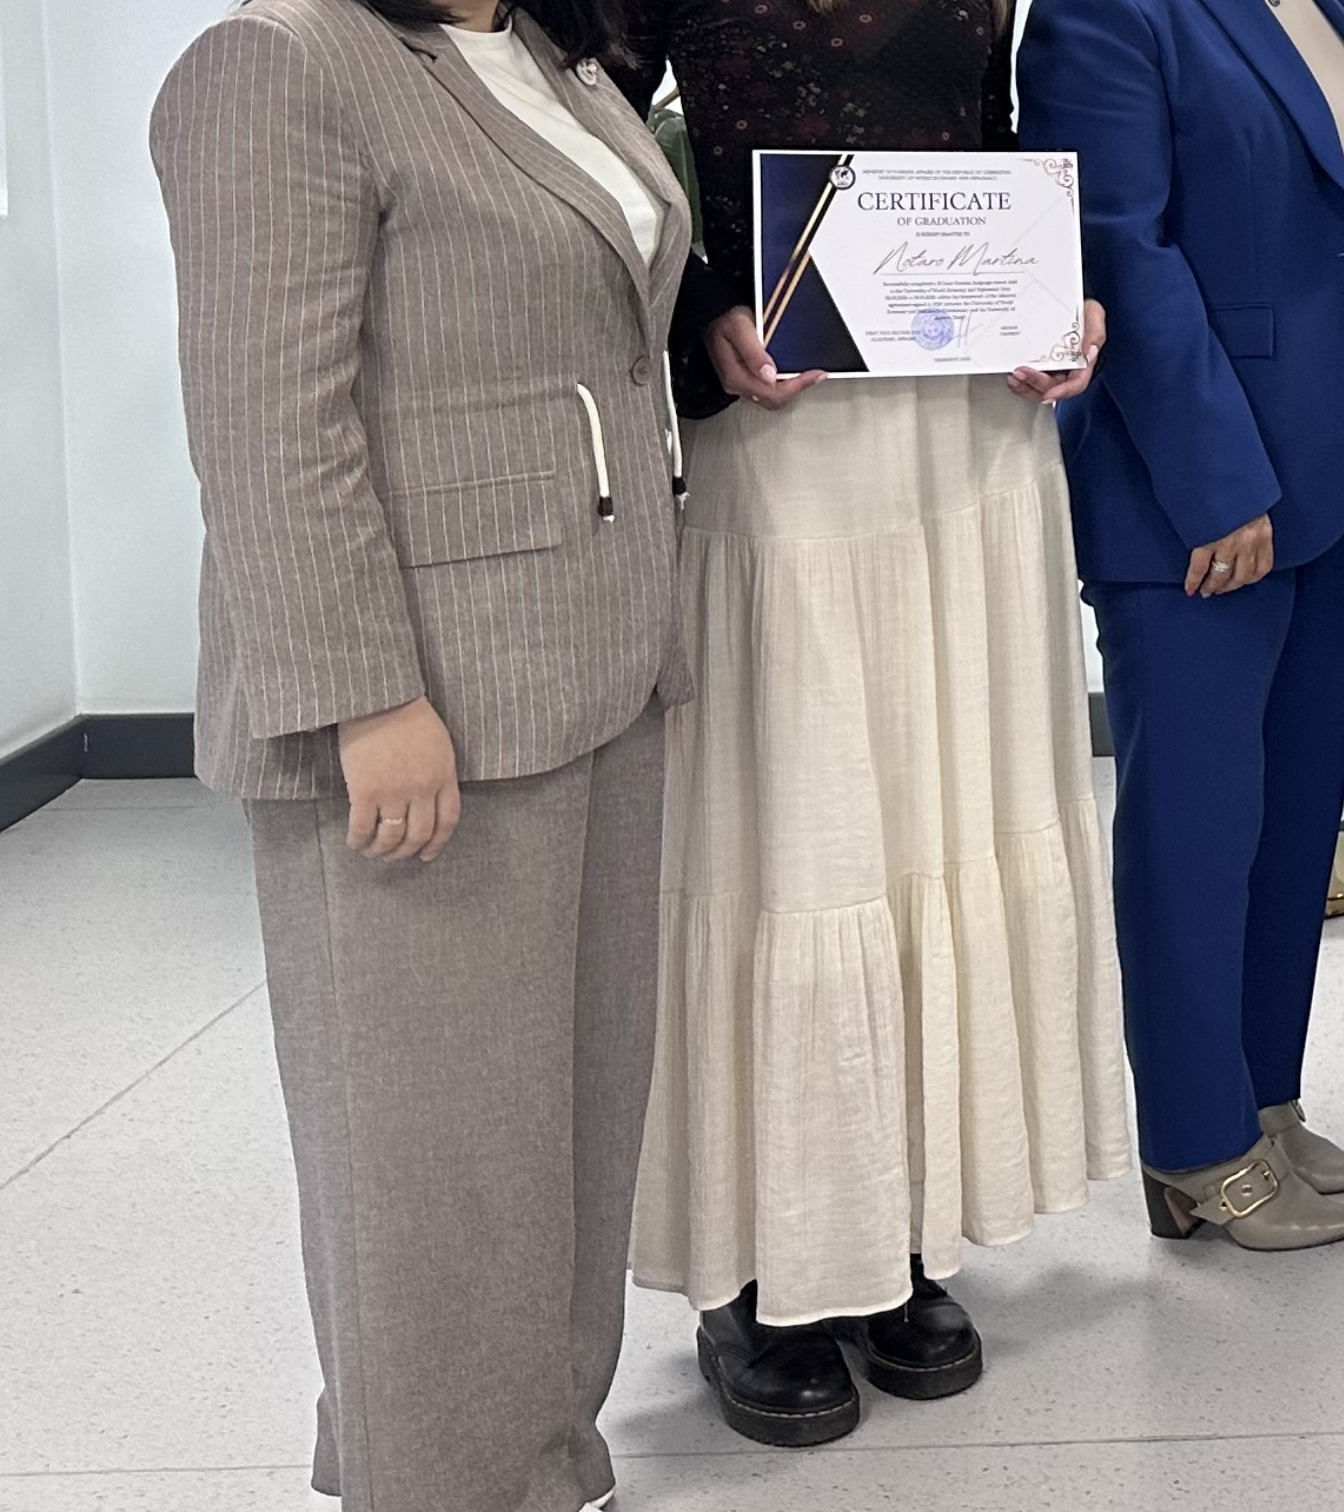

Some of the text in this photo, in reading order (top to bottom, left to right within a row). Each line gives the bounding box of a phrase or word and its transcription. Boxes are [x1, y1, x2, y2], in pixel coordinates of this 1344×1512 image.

[857, 191, 1012, 211] CERTIFICATE
[897, 216, 987, 226] OF GRADUATION
